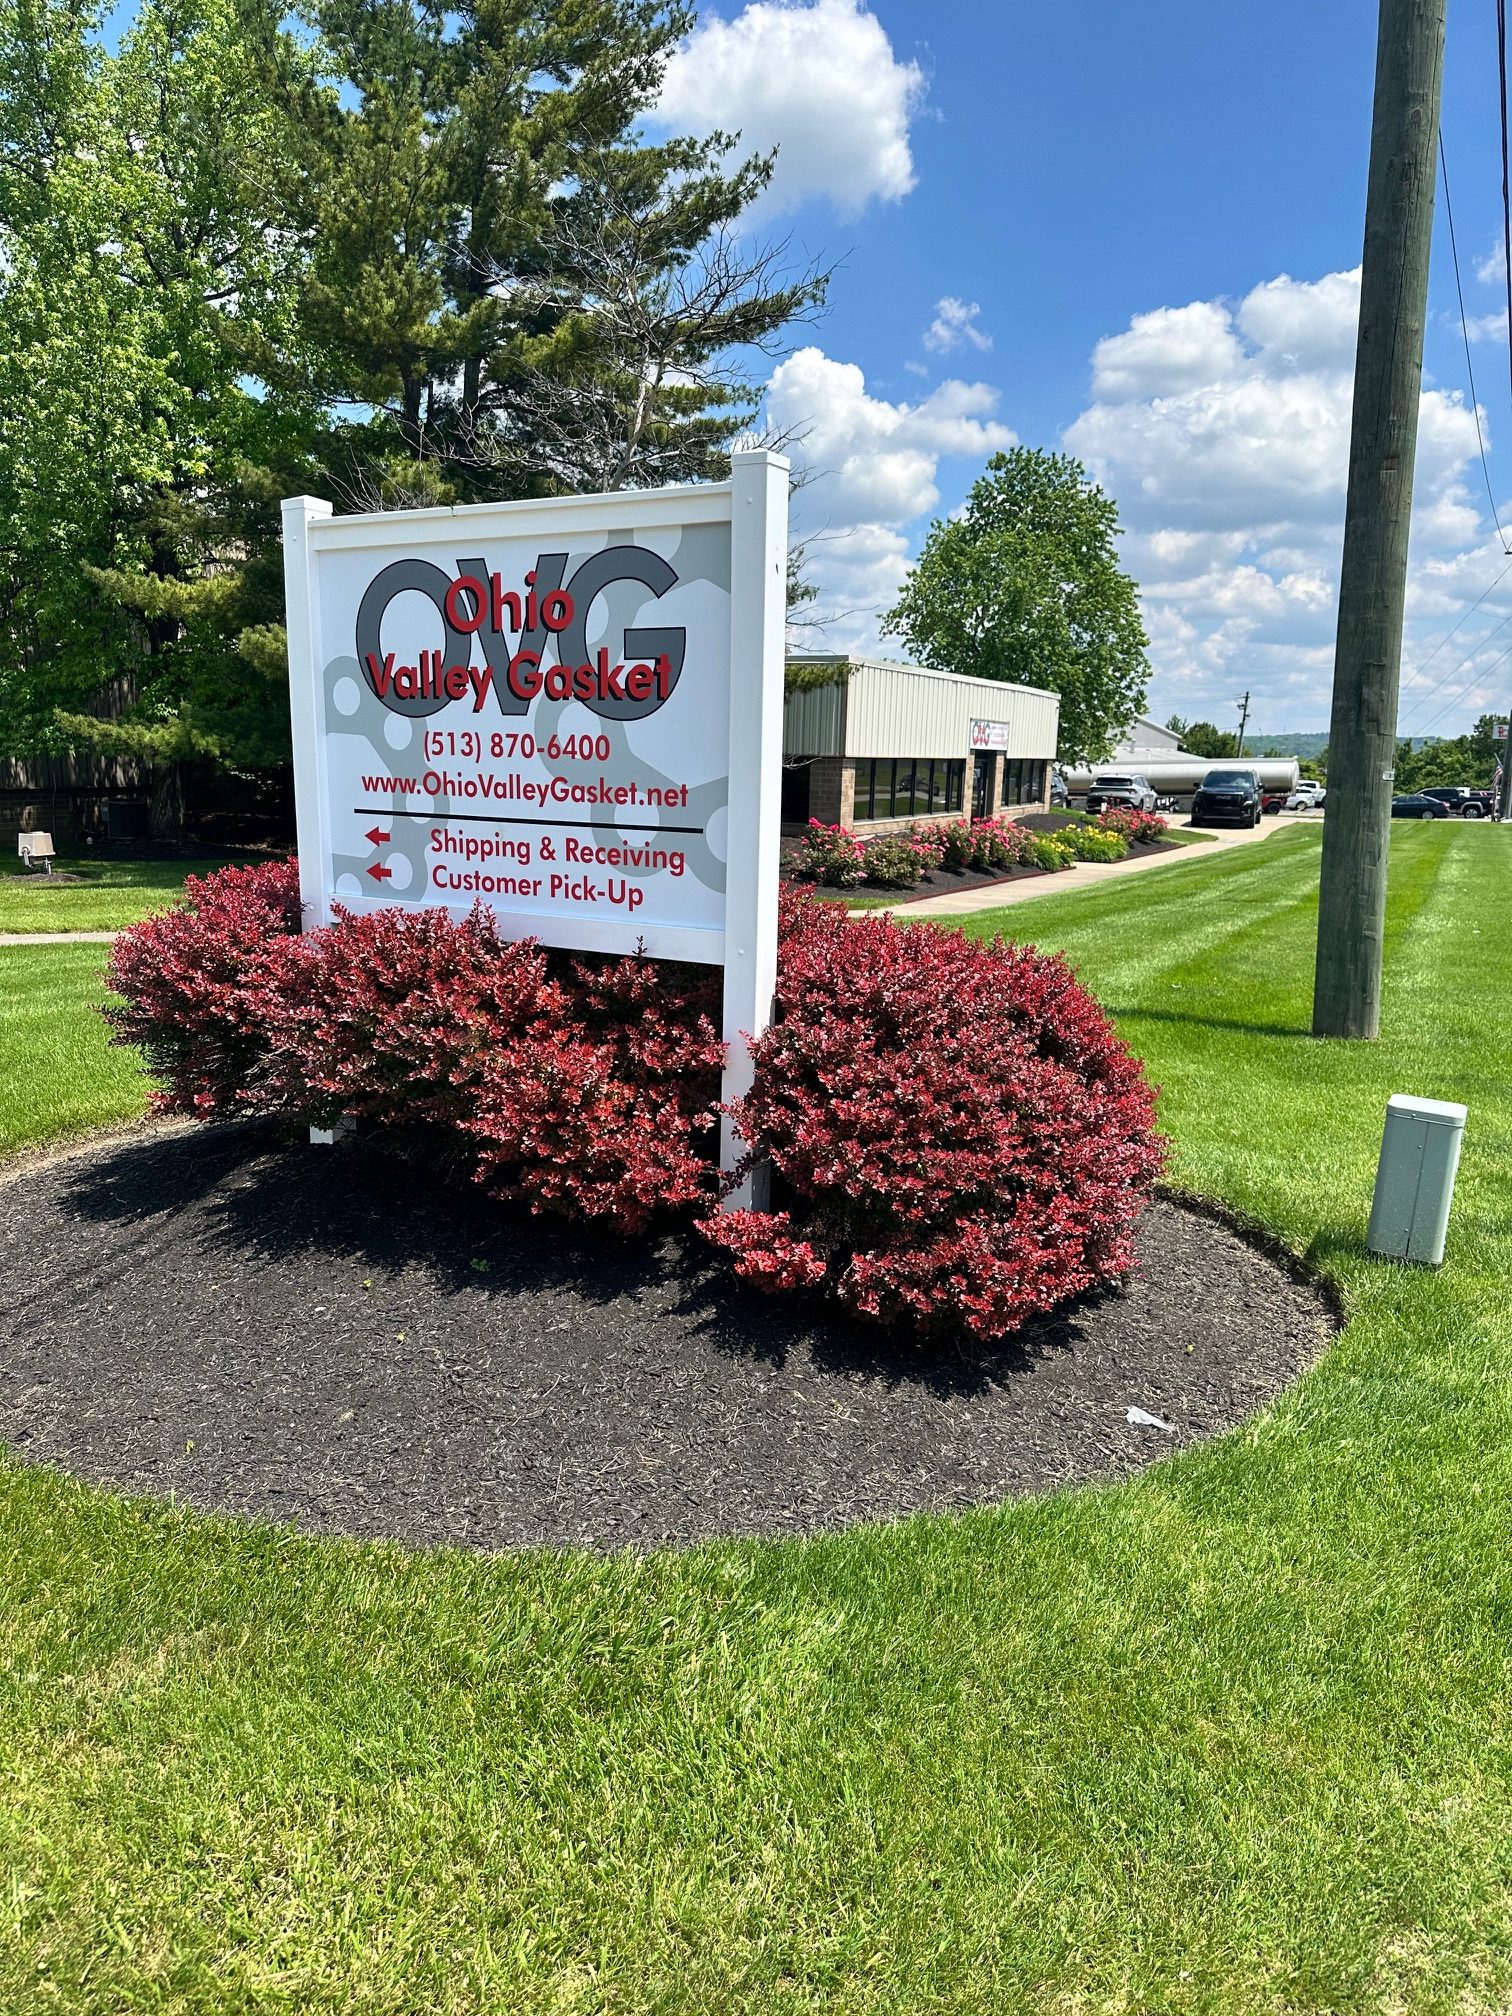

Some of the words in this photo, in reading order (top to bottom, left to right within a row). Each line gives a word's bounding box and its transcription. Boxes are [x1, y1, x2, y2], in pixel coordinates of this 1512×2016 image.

[444, 571, 575, 634] Ohio
[356, 545, 686, 721] OVG
[366, 649, 493, 713] Valley
[507, 647, 672, 701] Gasket
[424, 731, 482, 764] (513)
[490, 733, 611, 761] 870-6400
[361, 771, 689, 808] www.OhioValleyGasket.net
[431, 829, 531, 865] Shipping
[539, 836, 556, 861] &
[565, 838, 686, 877] Receiving
[432, 865, 542, 898] Customer
[550, 874, 645, 912] Pick-Up
